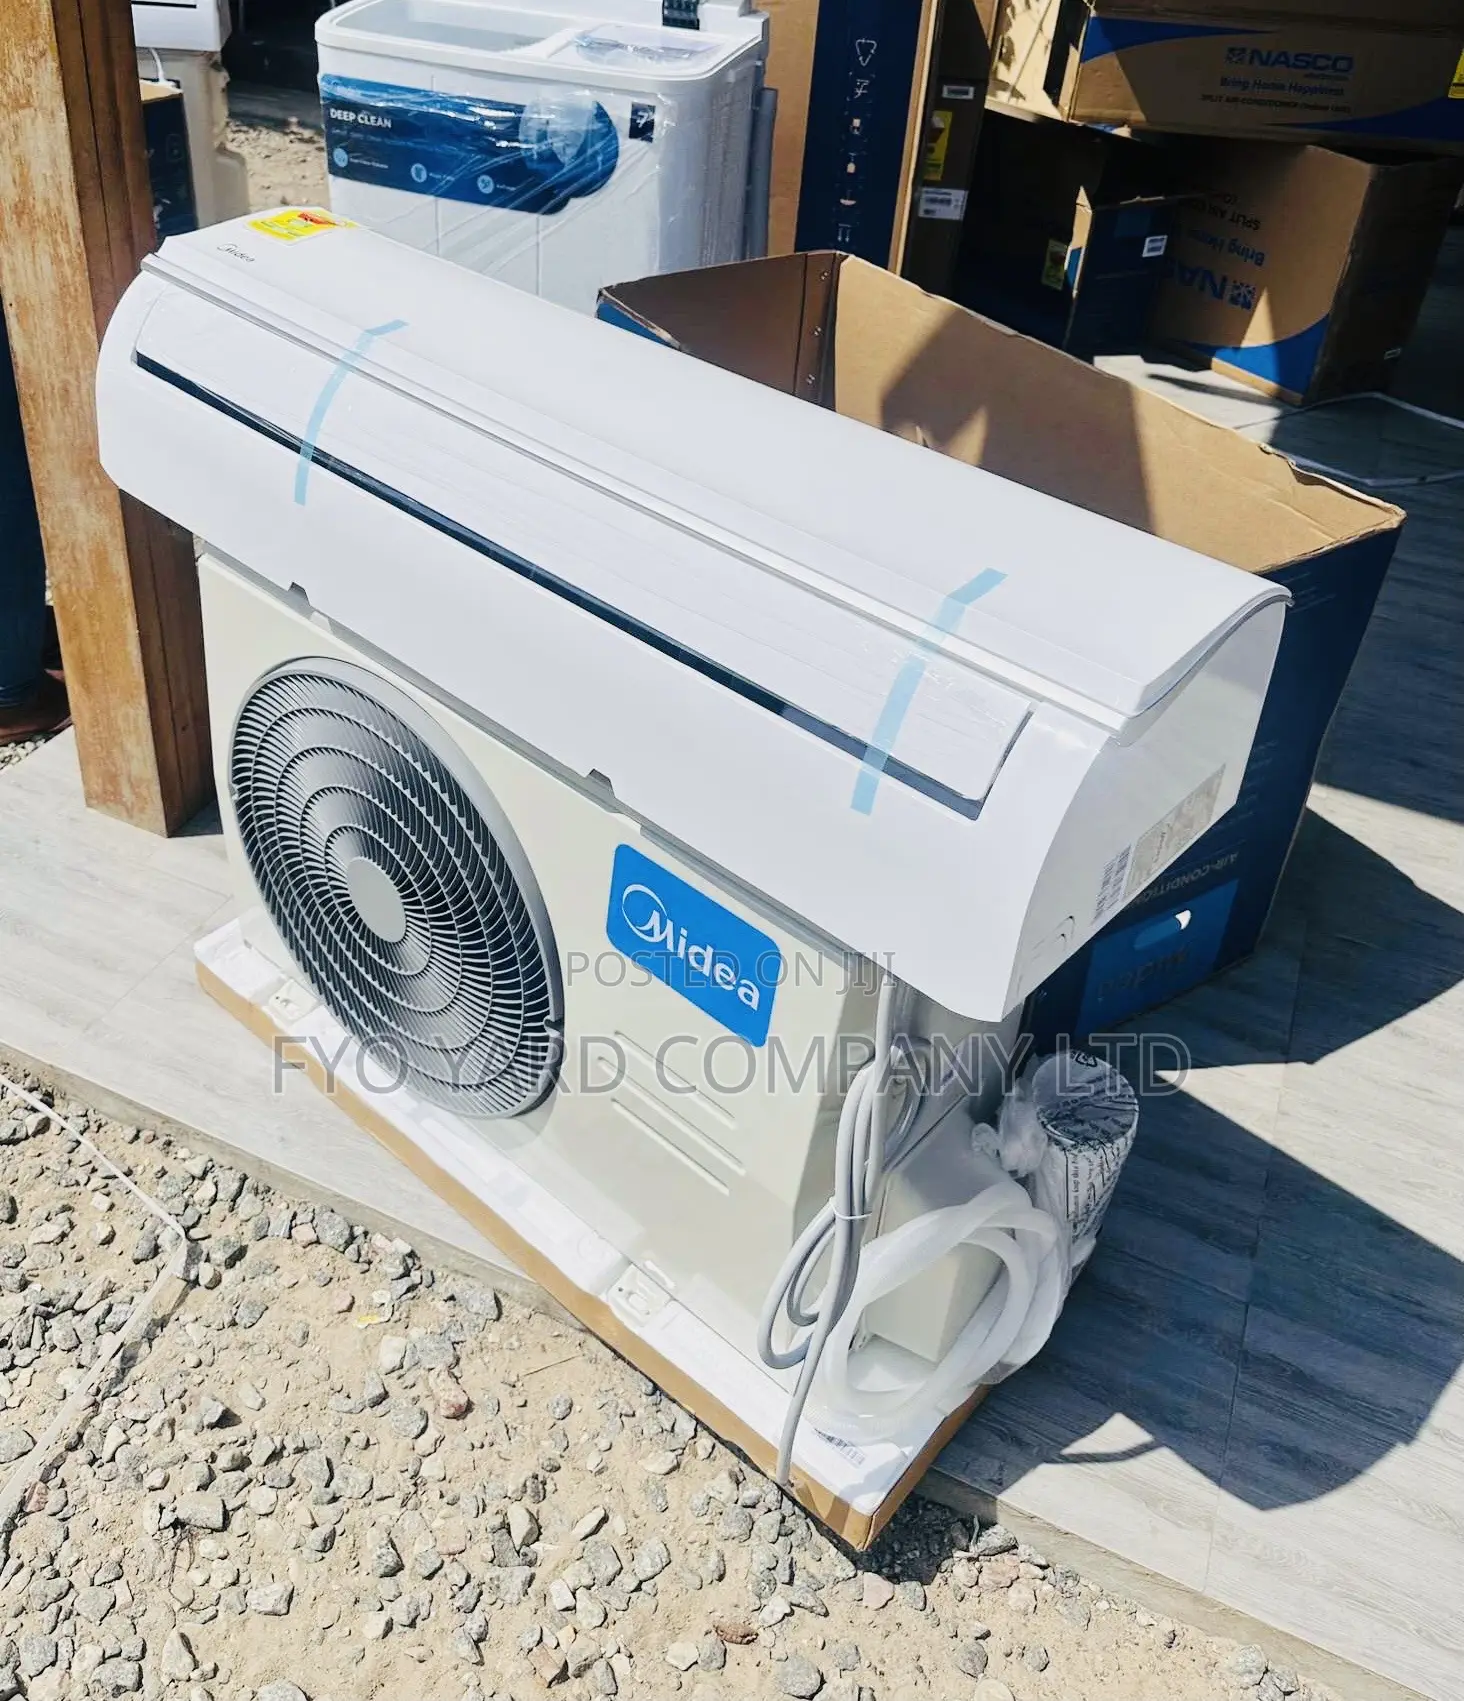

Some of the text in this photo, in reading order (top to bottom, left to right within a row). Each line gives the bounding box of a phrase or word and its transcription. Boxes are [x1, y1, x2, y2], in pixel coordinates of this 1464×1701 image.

[1250, 49, 1354, 73] NASCO
[1220, 76, 1249, 92] Bring
[1253, 77, 1286, 92] Home
[329, 108, 392, 129] DEEP CLEAN
[1229, 212, 1261, 231] SPLIT
[216, 243, 256, 263] Midea
[1228, 239, 1265, 267] Bring
[621, 884, 760, 1013] Midea
